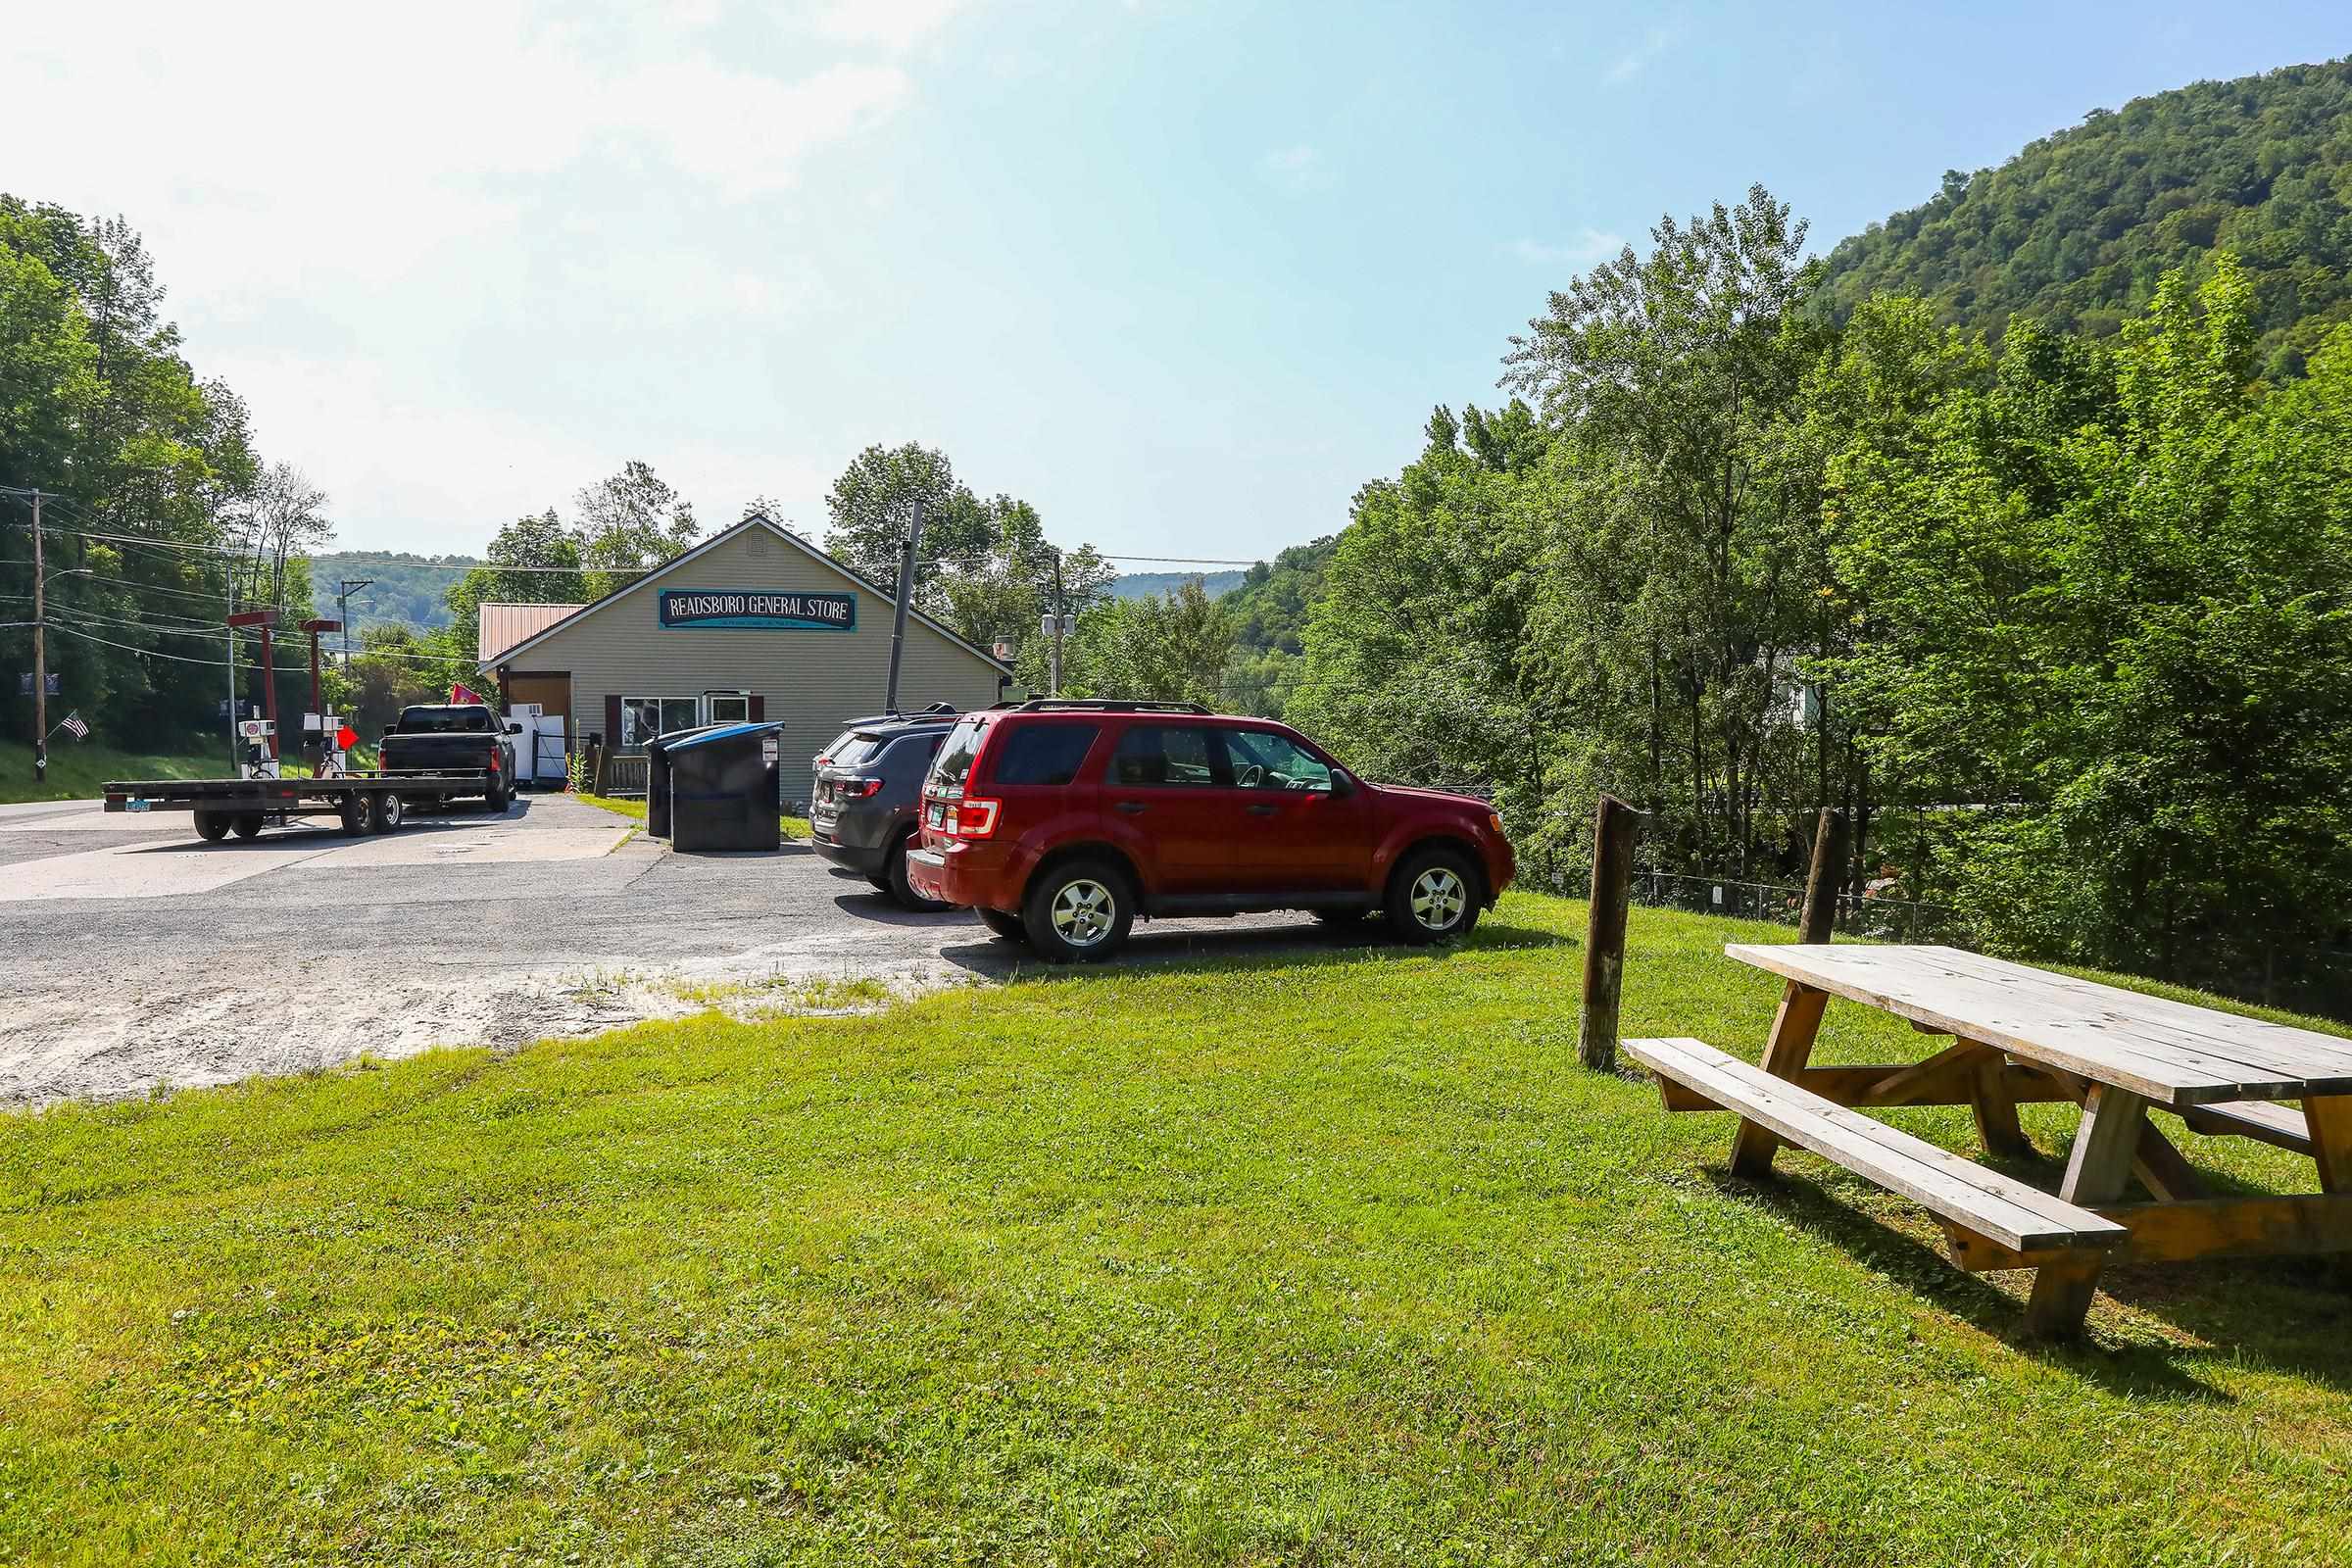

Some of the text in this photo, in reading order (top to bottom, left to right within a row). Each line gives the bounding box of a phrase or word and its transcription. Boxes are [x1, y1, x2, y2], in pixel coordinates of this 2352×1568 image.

[669, 595, 849, 620] READSBORO GENERAL STORE
